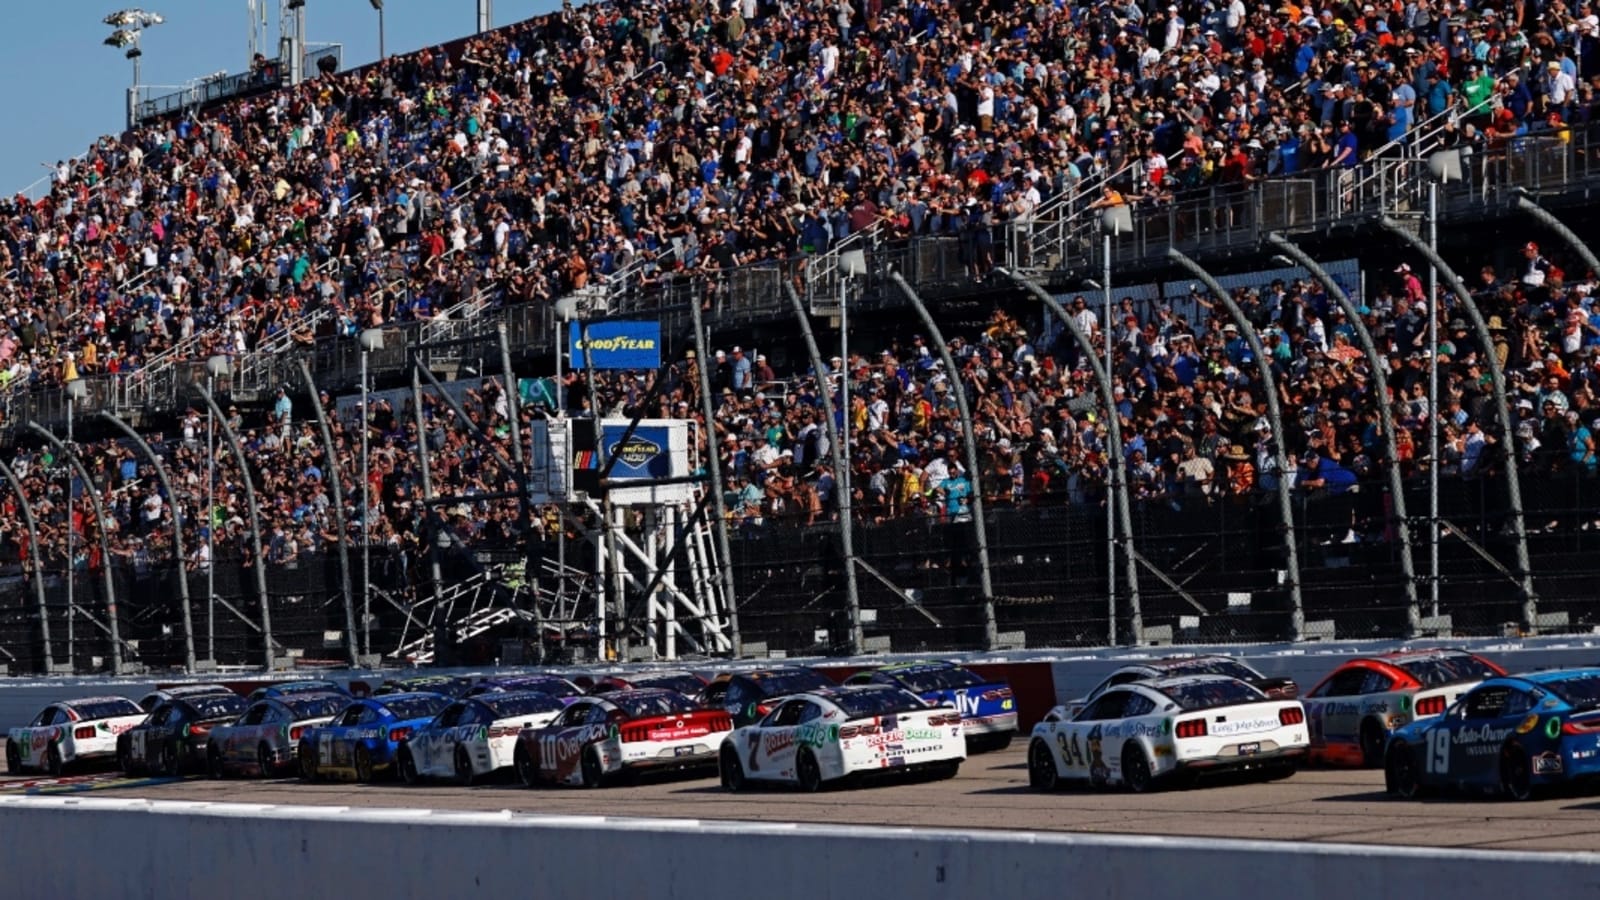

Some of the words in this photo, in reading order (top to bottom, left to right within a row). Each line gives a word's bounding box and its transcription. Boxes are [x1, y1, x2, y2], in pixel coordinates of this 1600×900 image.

[866, 731, 905, 748] Razzle
[905, 728, 943, 740] Dazzle
[951, 727, 959, 737] 7
[1057, 731, 1087, 767] 34
[539, 734, 558, 770] 10
[748, 731, 762, 772] 7
[1426, 728, 1450, 773] 19
